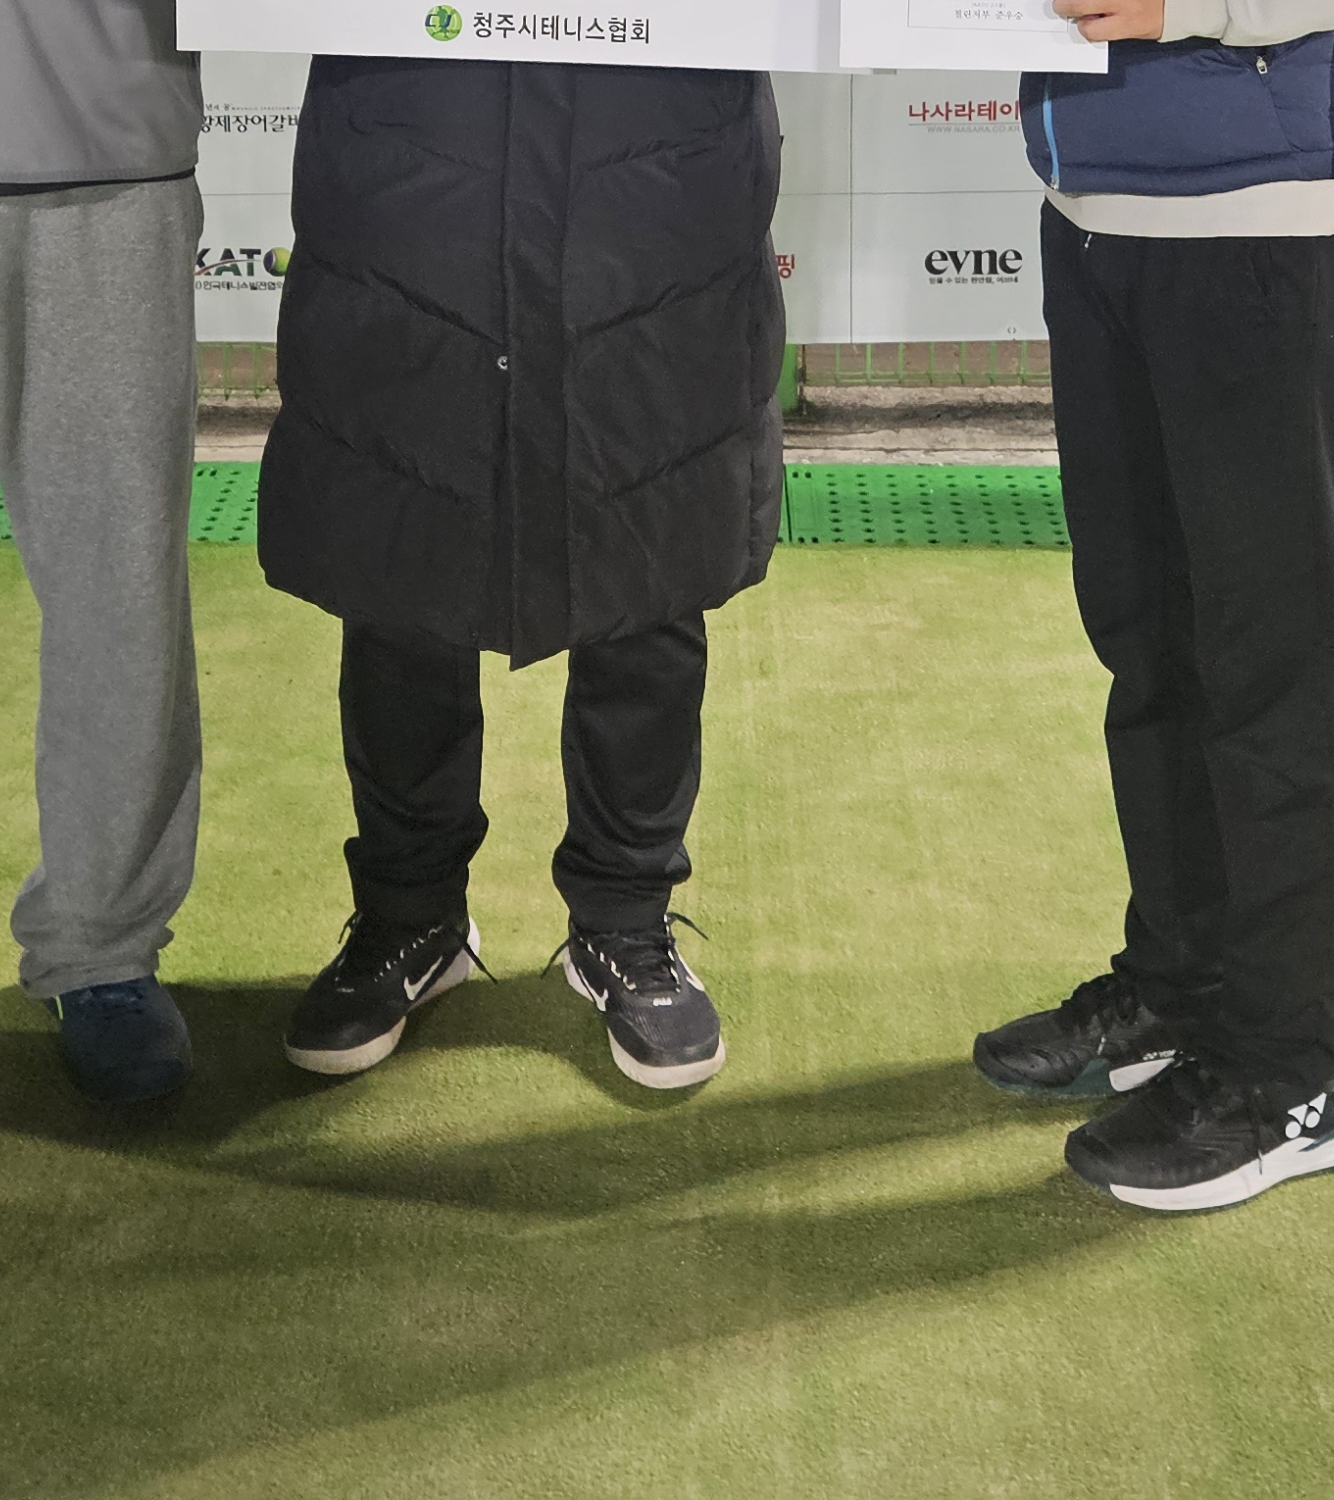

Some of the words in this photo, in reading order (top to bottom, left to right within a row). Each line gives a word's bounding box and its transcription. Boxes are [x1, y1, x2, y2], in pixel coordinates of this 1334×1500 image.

[473, 11, 650, 44] 청주시테니스협회
[909, 100, 1019, 122] 나사라테이
[924, 249, 1023, 275] evne
